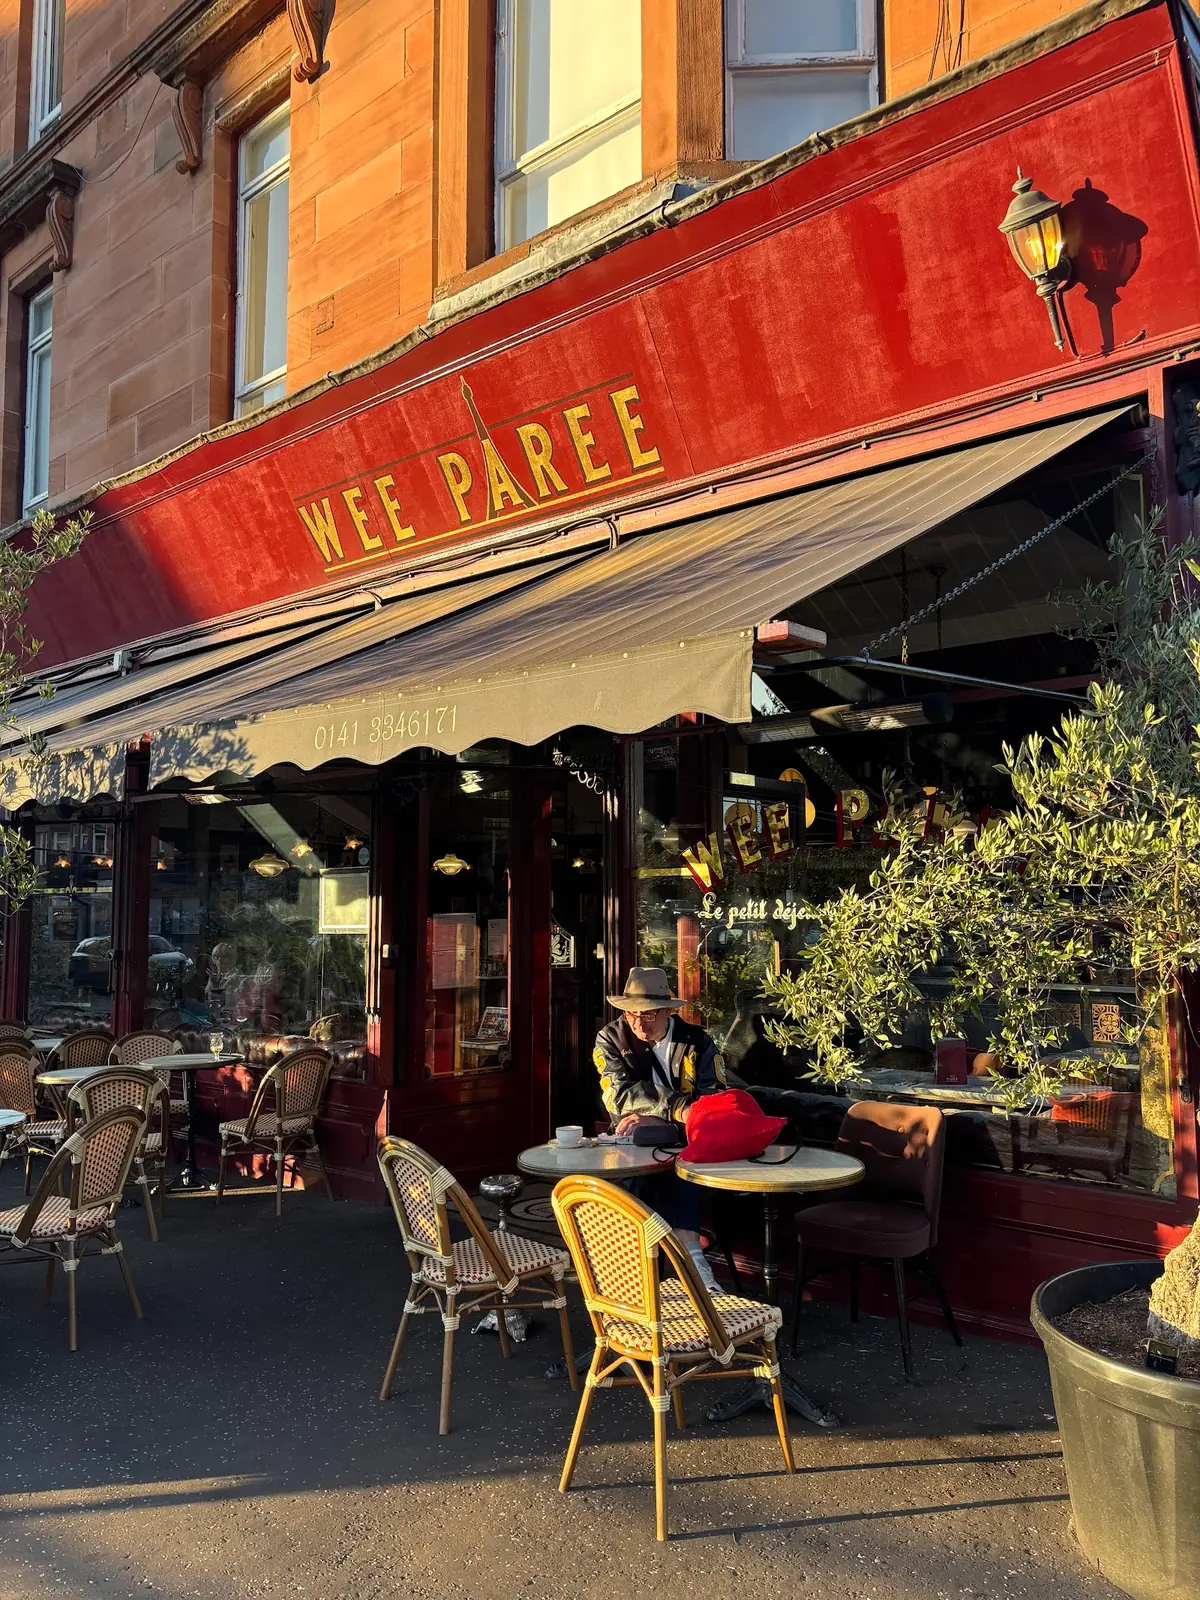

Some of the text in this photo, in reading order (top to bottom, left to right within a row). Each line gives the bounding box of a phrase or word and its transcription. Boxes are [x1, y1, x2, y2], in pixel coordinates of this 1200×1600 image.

[298, 384, 661, 563] WEE PAREE
[314, 705, 457, 750] 0141 3346171
[680, 801, 795, 891] WEE
[695, 891, 724, 919] Le
[725, 898, 767, 929] petit
